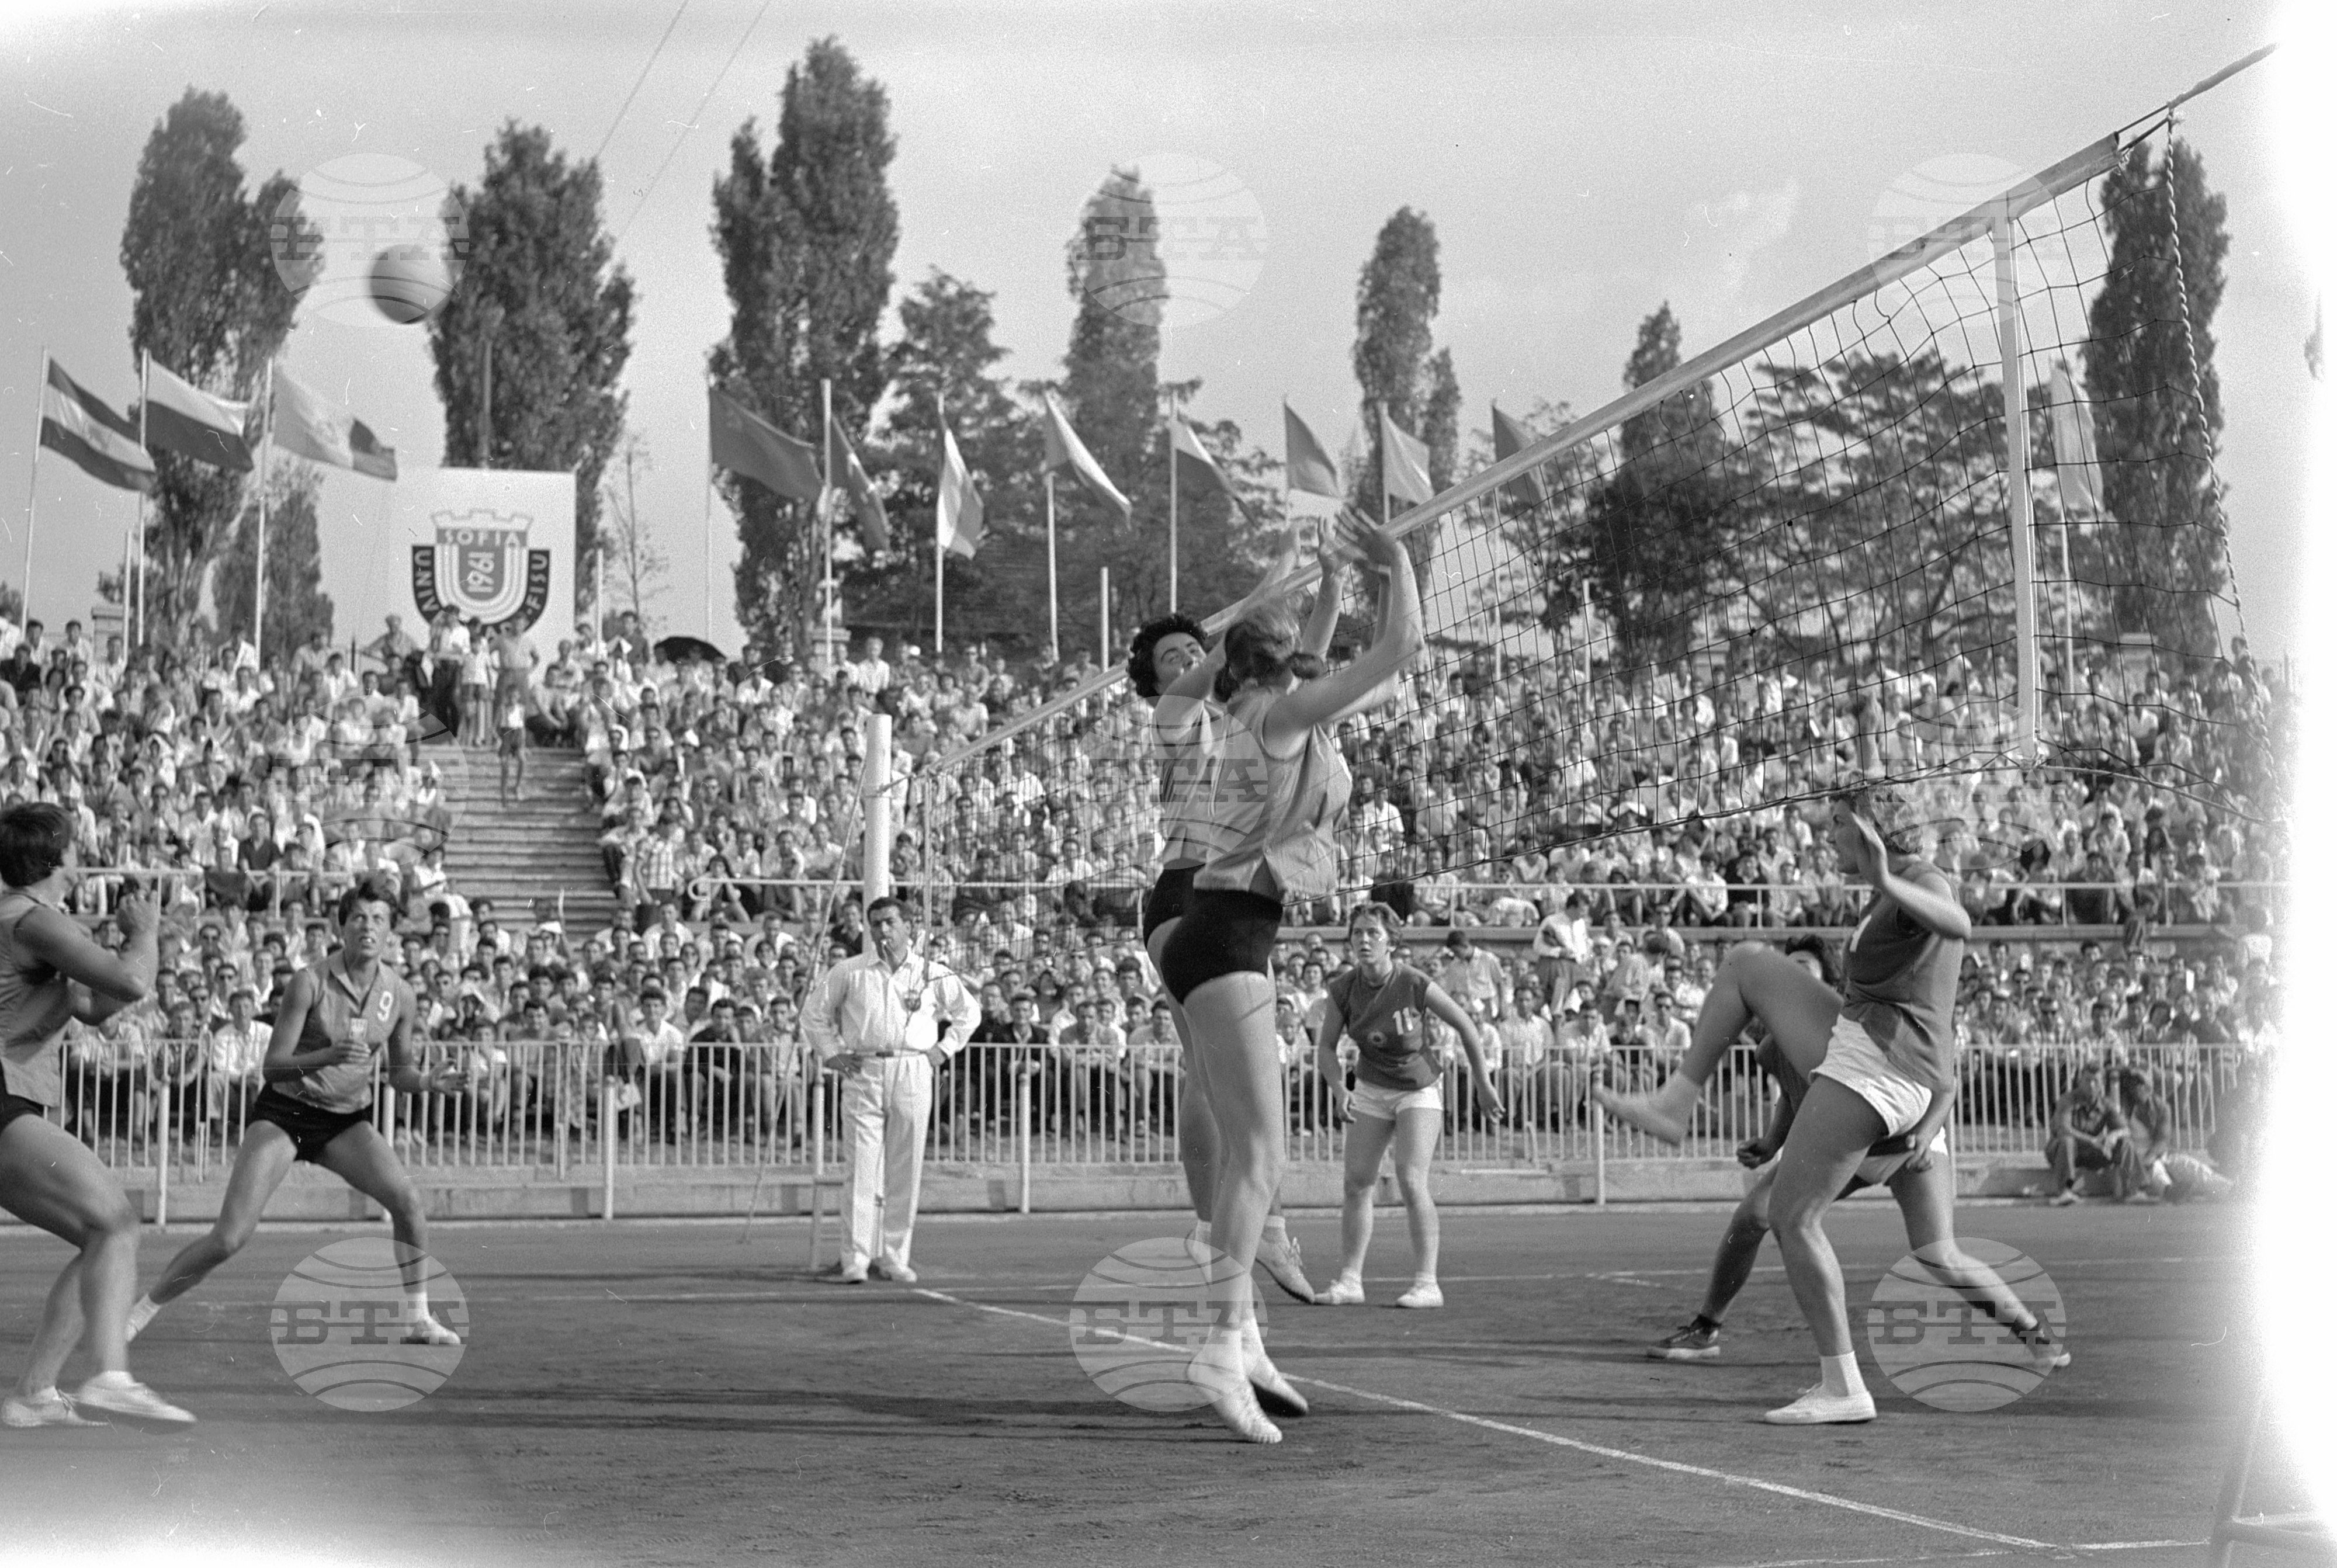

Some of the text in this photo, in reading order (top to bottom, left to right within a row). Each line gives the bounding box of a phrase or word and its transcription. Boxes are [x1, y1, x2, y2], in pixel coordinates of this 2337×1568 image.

[445, 528, 521, 547] SOFIA
[468, 551, 495, 592] 1961
[377, 991, 393, 1022] 9
[1392, 1007, 1413, 1036] 11
